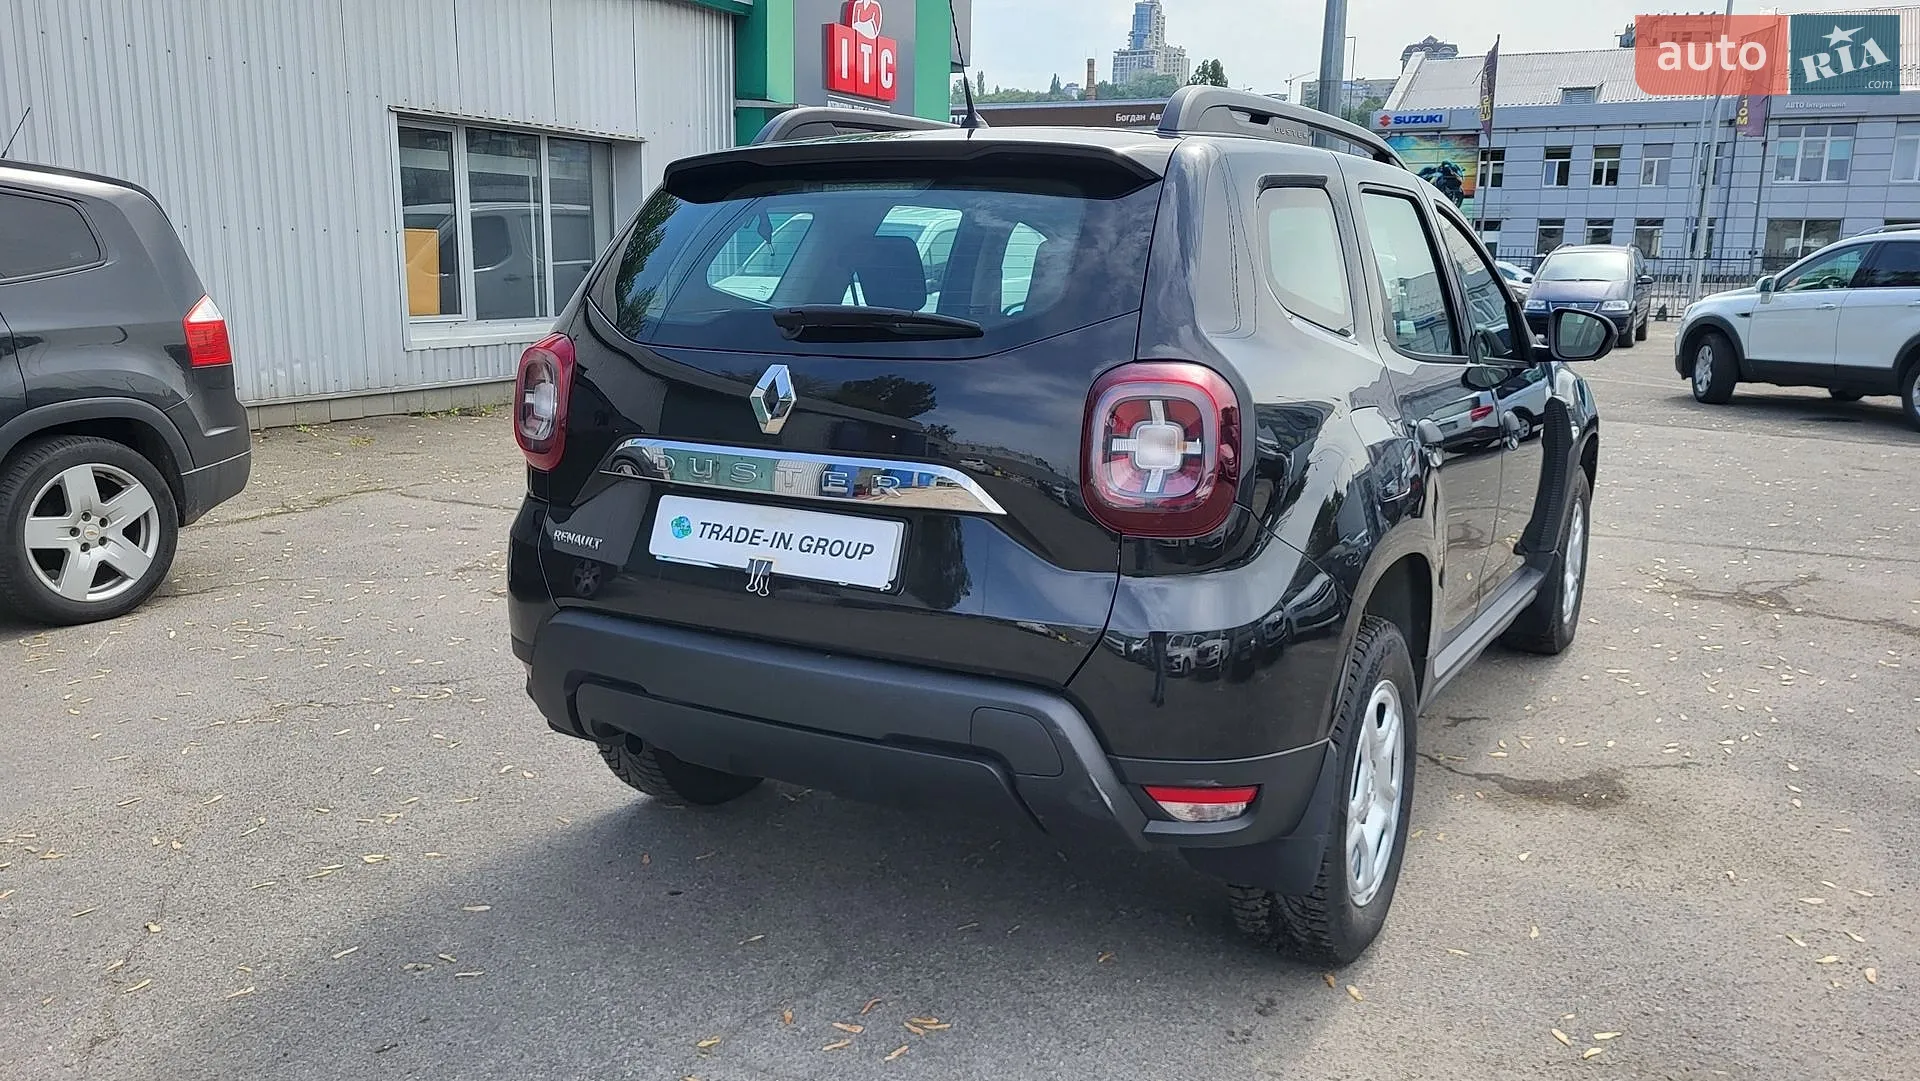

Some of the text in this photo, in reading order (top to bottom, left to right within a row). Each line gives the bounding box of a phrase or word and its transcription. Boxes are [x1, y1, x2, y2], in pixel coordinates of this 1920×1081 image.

[841, 38, 893, 88] ITC
[1115, 112, 1163, 123] Богдан Ав
[1393, 114, 1443, 125] SUZUKI
[654, 455, 902, 497] DUSTER
[553, 529, 603, 550] RENAULT
[798, 535, 875, 561] GROUP
